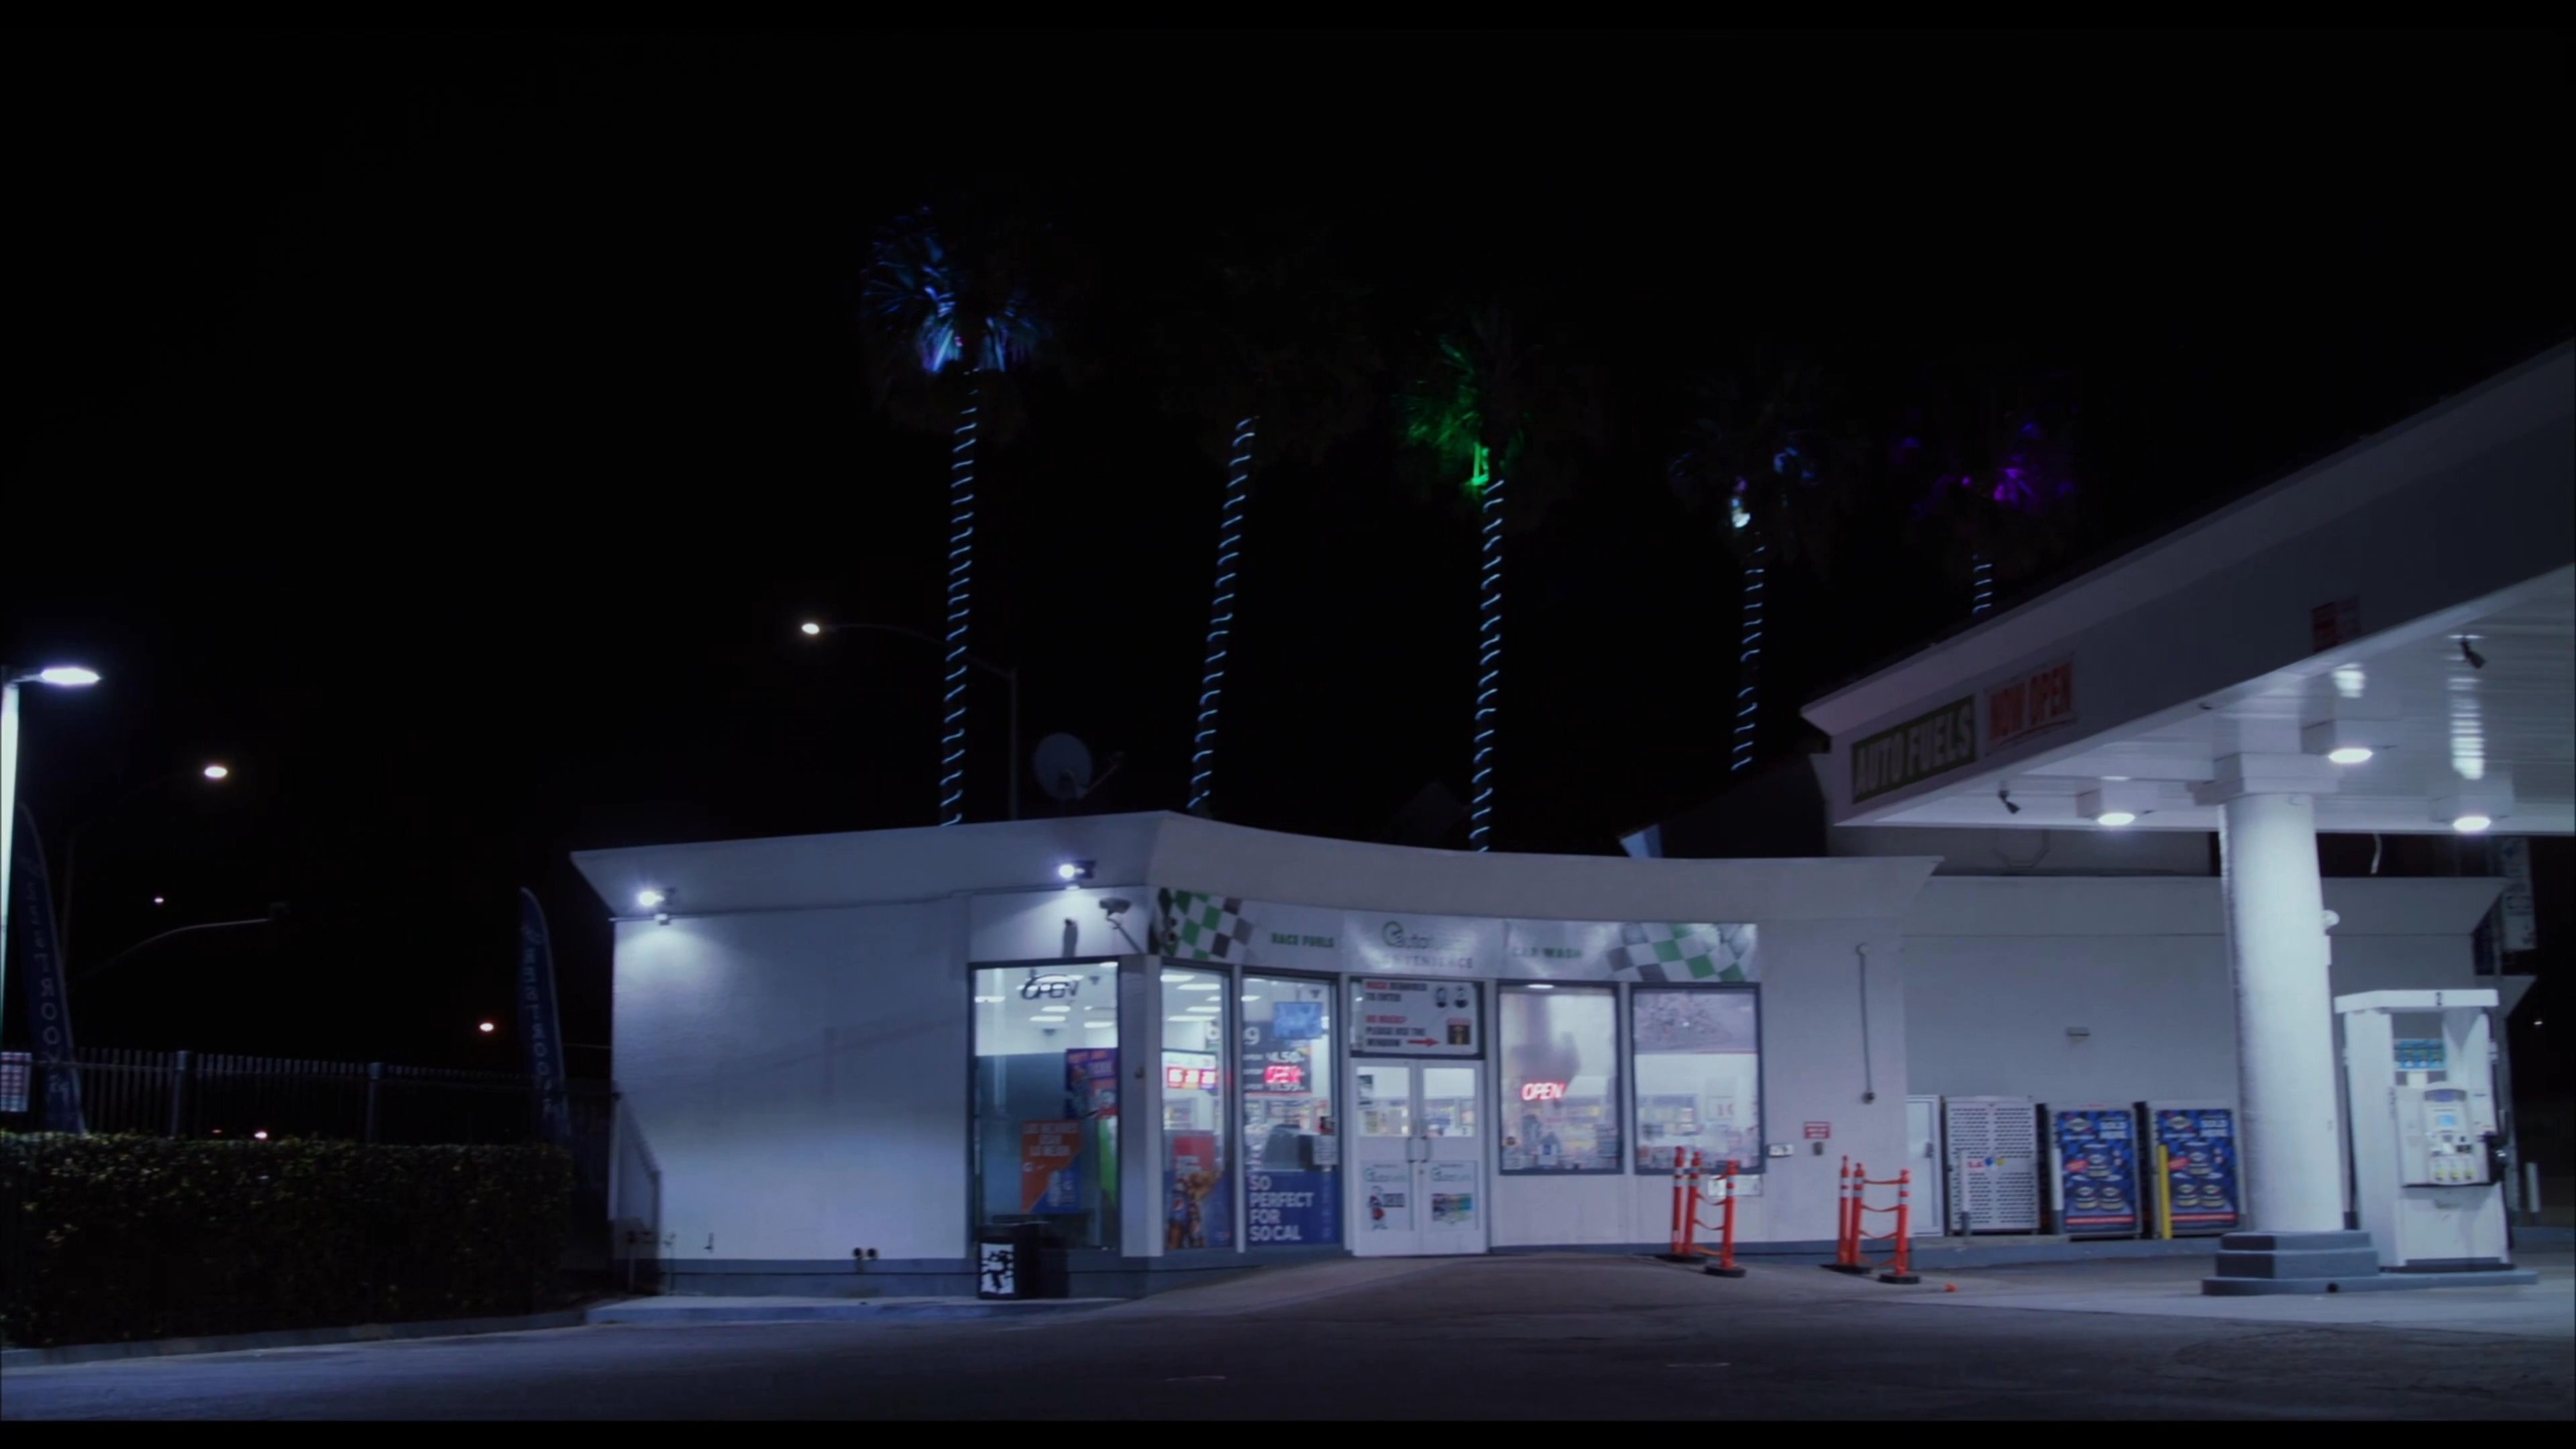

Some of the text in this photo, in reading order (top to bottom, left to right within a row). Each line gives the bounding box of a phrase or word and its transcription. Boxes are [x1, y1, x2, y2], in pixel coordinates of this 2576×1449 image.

[1990, 663, 2073, 741] NOW OPEN
[1854, 704, 1973, 794] AUTO FUELS
[1271, 932, 1335, 947] RACE FUELS
[1544, 947, 1583, 958] WASH
[1521, 1081, 1567, 1101] OPEN
[1248, 1175, 1272, 1191] SO
[1249, 1192, 1315, 1208] PERFECT
[1249, 1208, 1281, 1224] FOR
